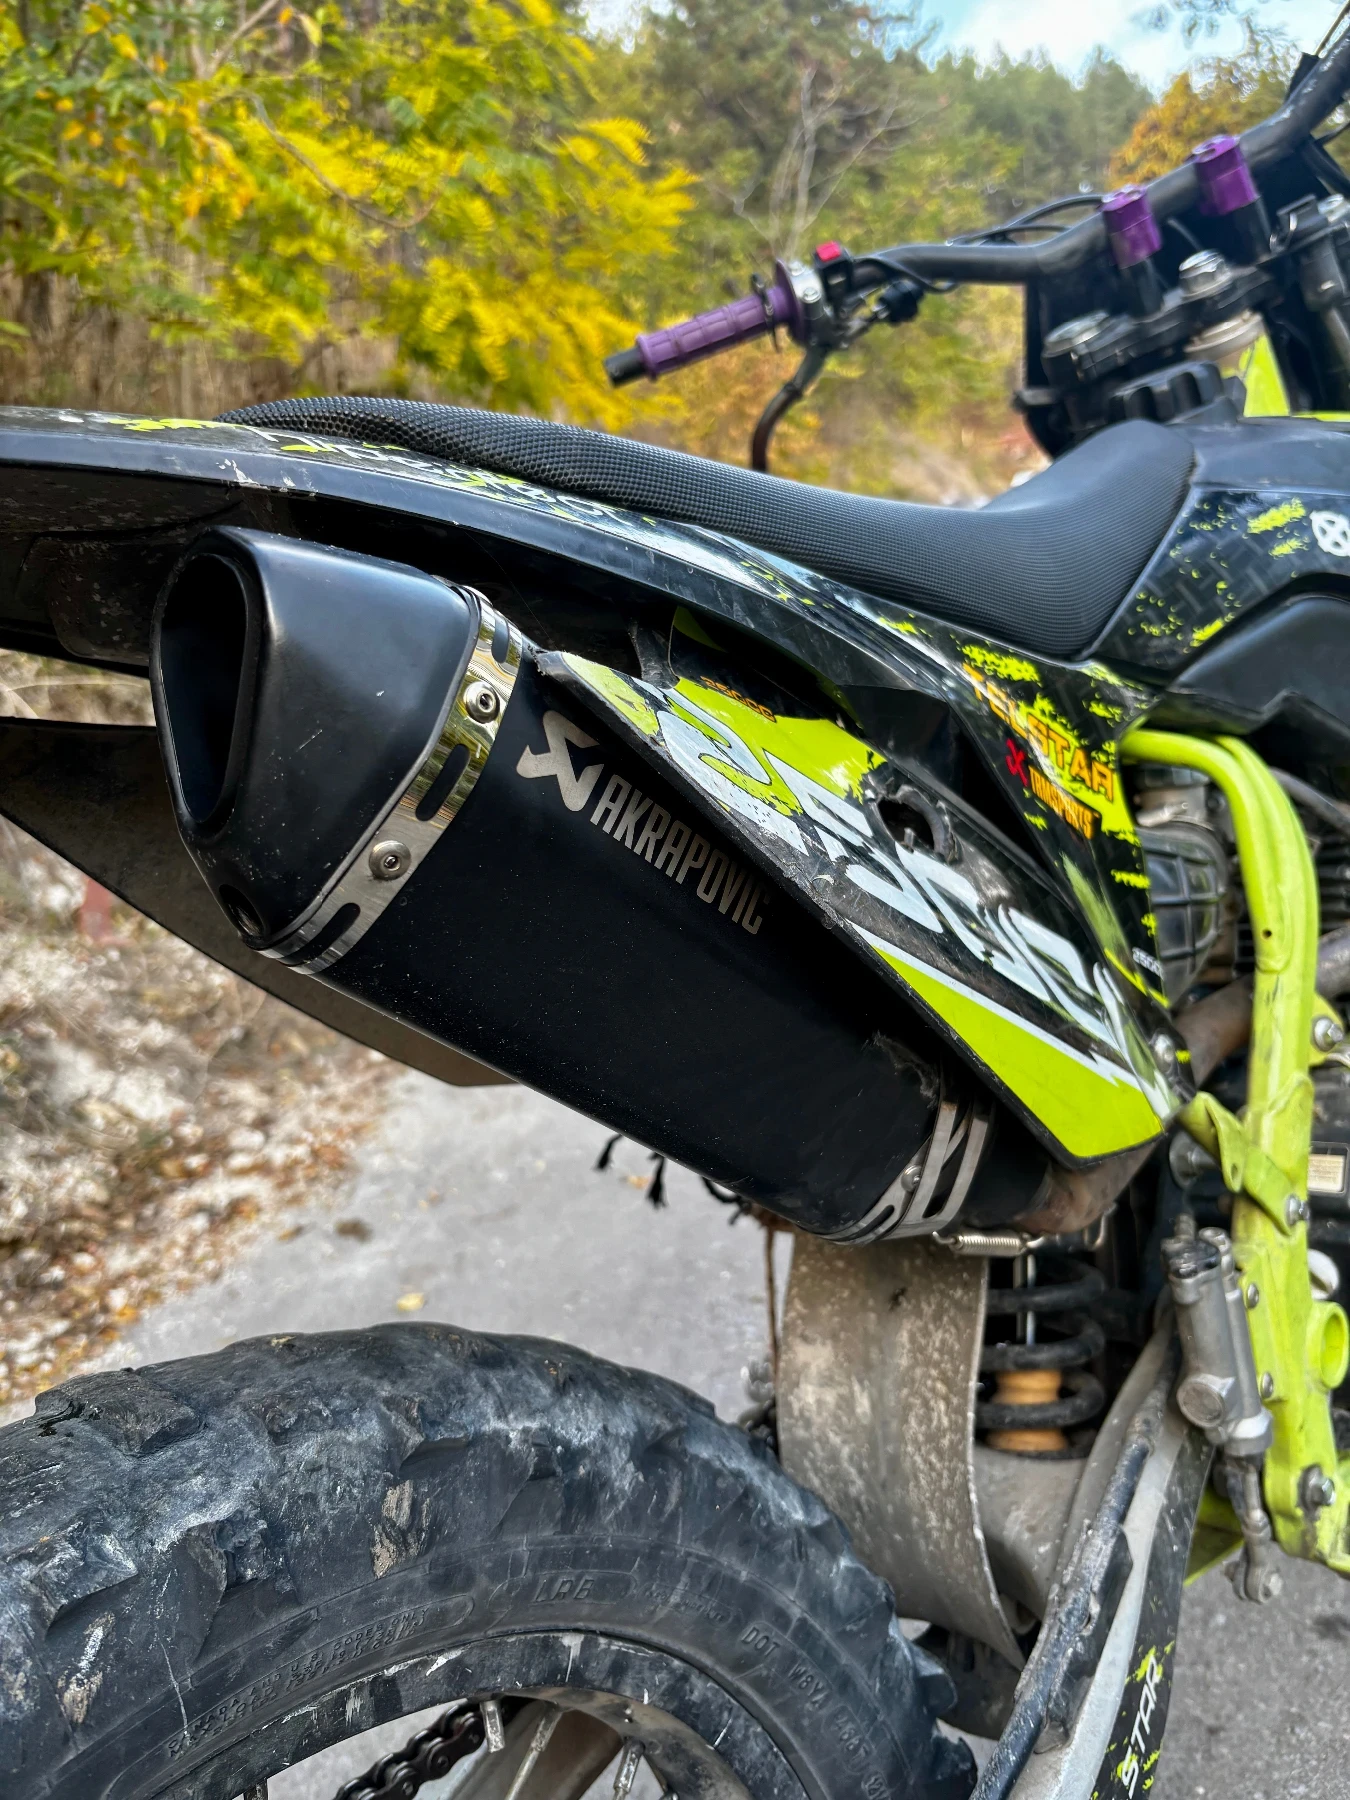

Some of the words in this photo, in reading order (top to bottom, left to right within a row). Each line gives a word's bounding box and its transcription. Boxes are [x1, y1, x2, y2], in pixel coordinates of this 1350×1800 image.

[963, 663, 1114, 802] TELSTAR
[590, 774, 771, 935] AKRAPOVIC
[333, 1622, 384, 1651] CODES
[741, 1626, 782, 1659] DOT
